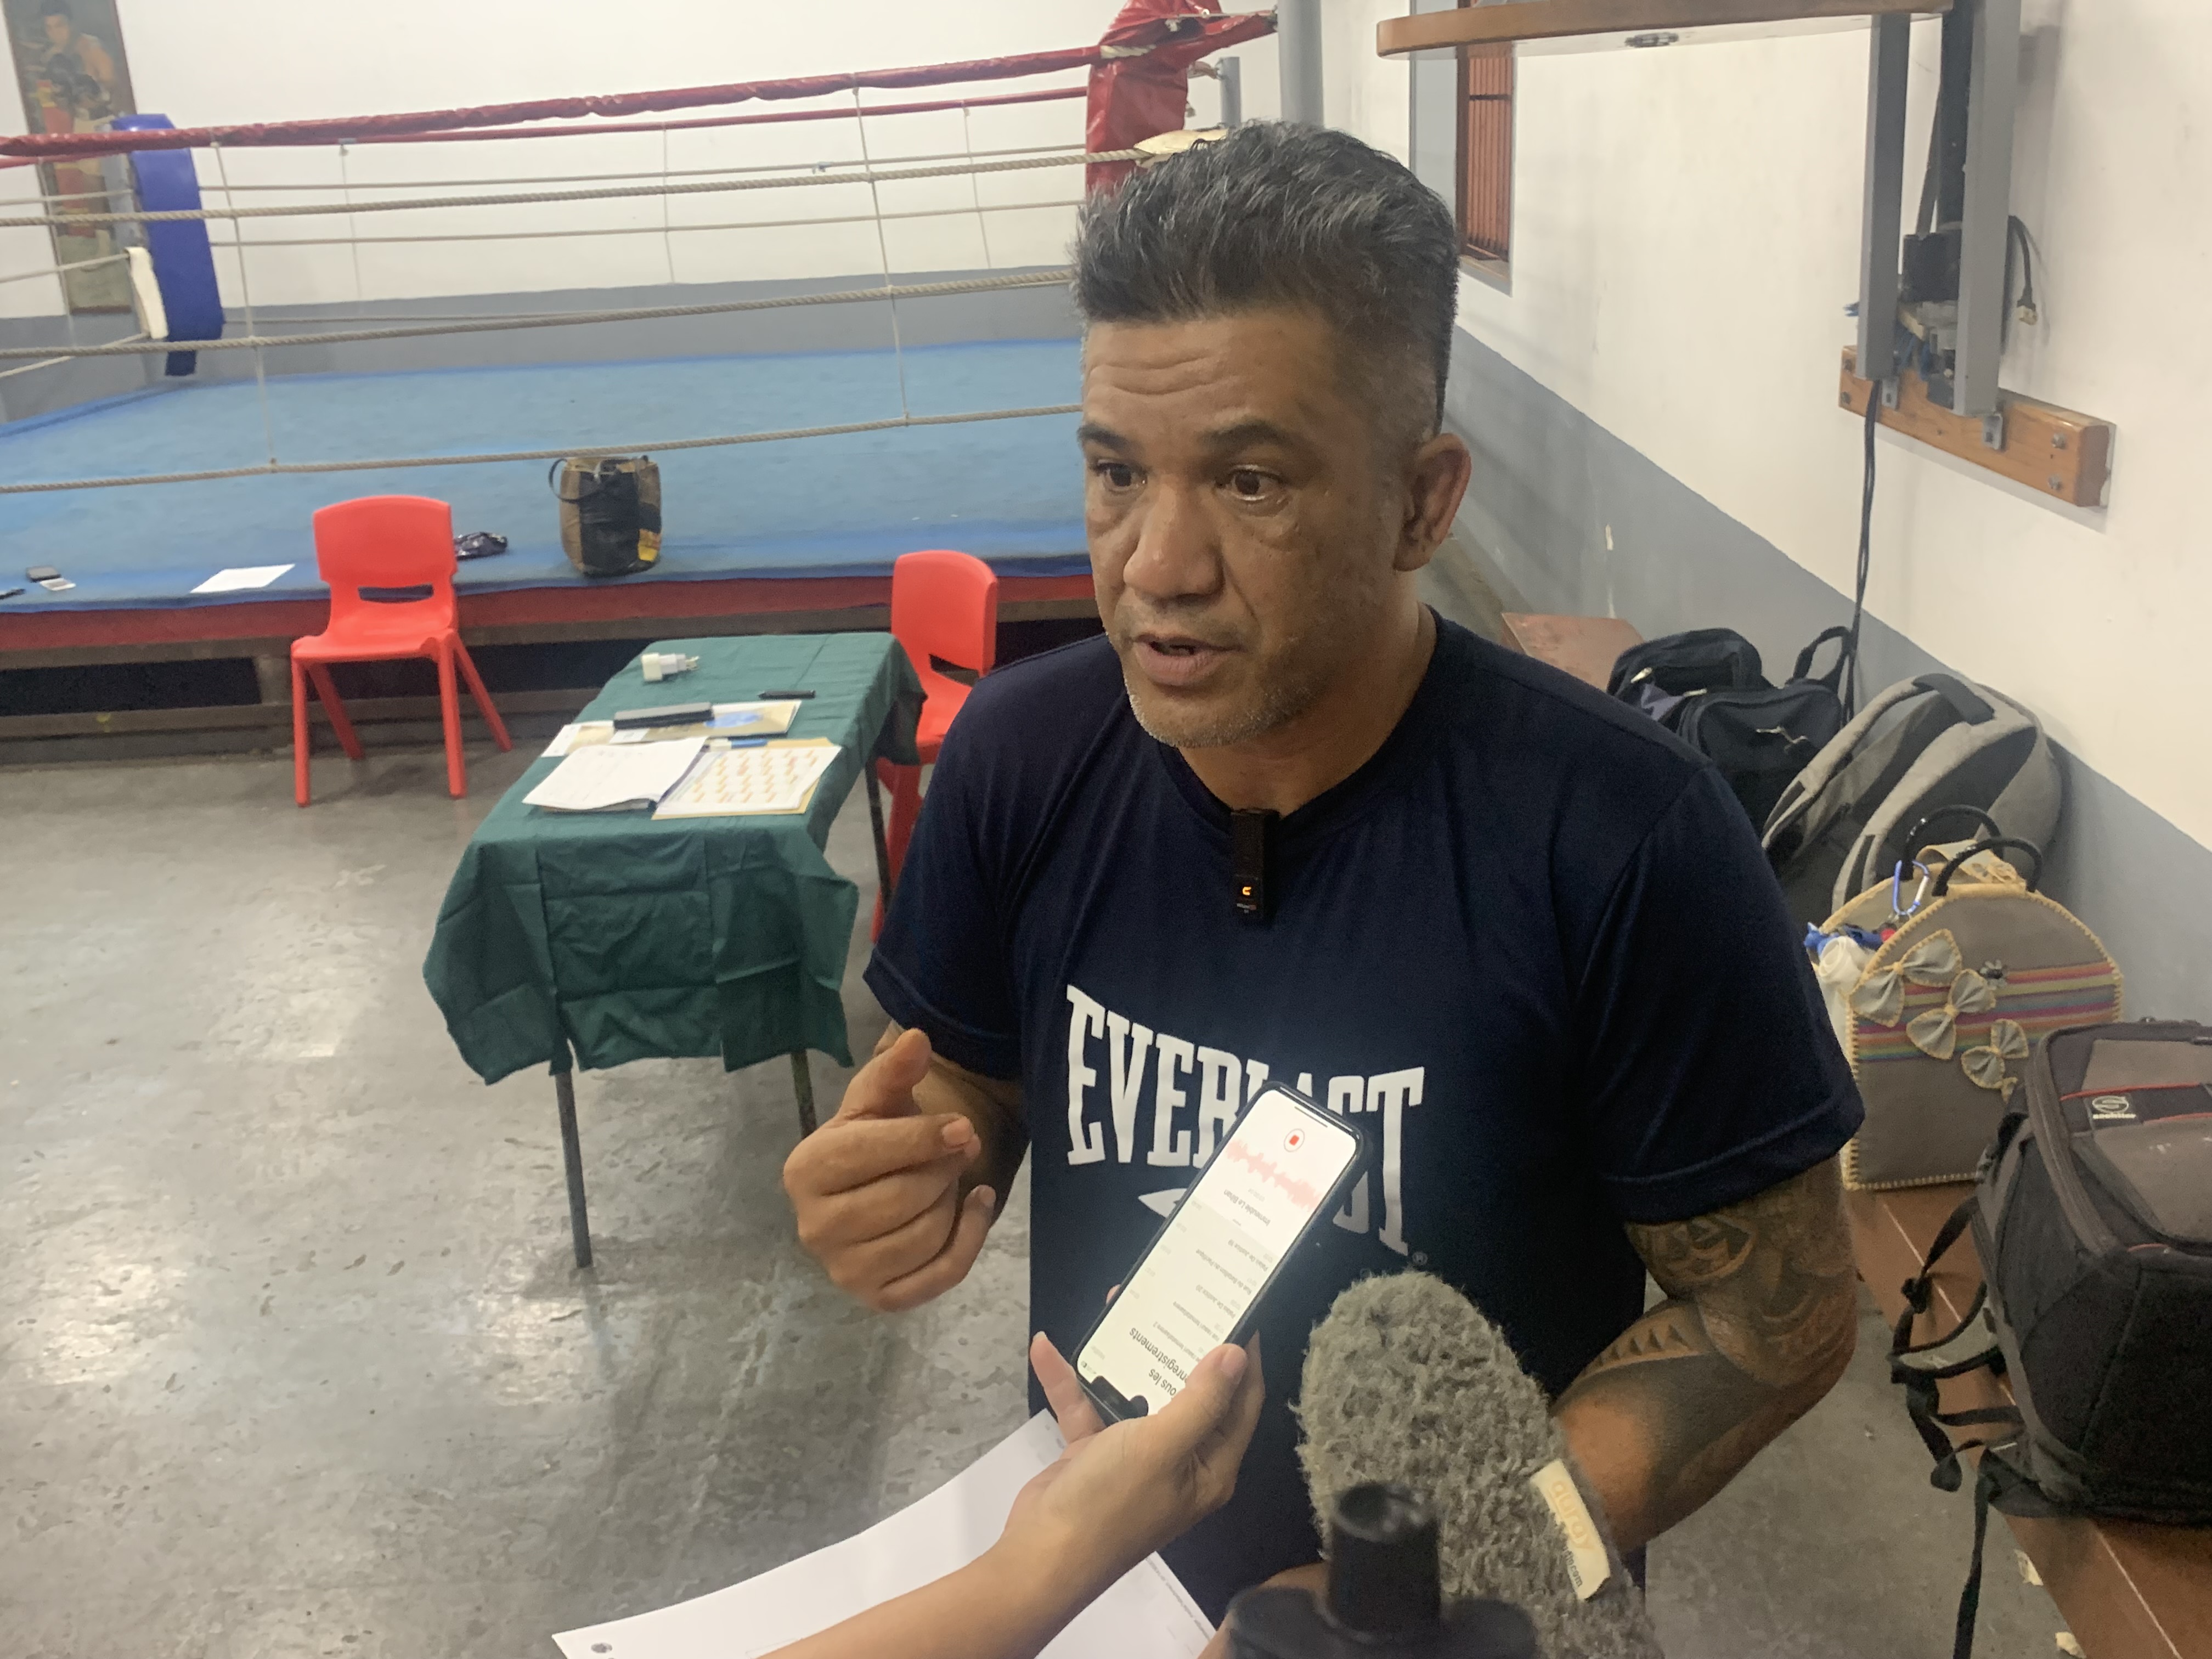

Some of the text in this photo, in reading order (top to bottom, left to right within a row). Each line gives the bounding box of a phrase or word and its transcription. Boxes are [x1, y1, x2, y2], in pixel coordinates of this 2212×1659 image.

[1066, 984, 1424, 1256] EVERST
[1222, 1189, 1238, 1203] Bihan
[1237, 1199, 1245, 1207] Le
[1244, 1205, 1269, 1225] Immeuble
[1242, 1285, 1252, 1294] Rue
[1147, 1369, 1178, 1397] ous les
